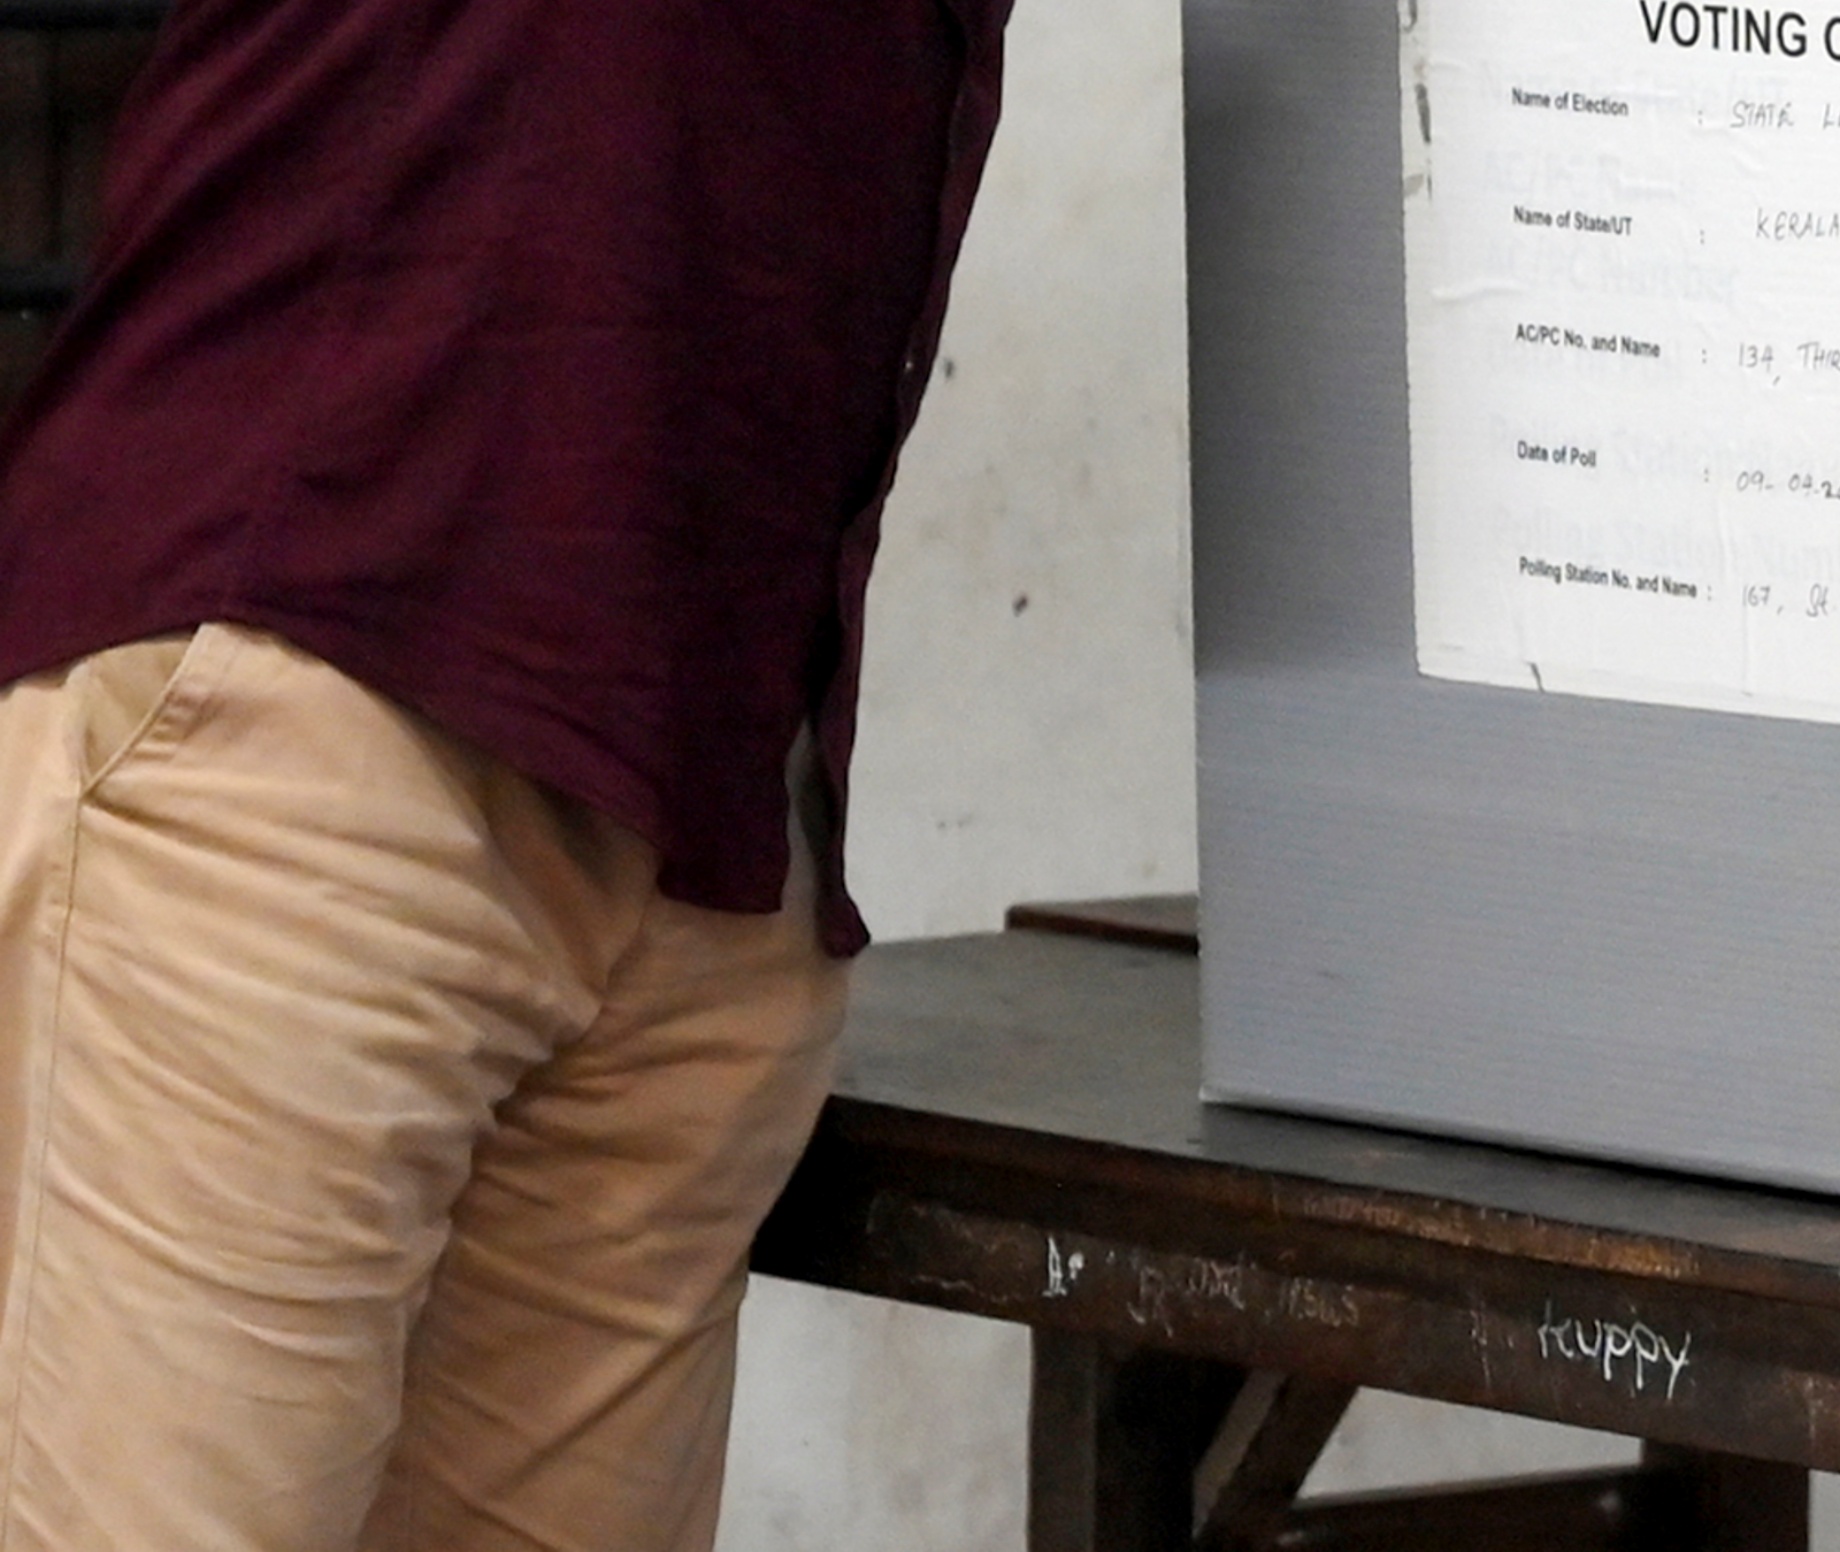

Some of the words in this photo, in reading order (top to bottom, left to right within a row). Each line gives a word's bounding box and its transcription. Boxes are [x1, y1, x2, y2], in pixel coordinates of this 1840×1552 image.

[1511, 86, 1552, 110] Name
[1553, 90, 1570, 111] of
[1571, 92, 1630, 117] Election
[1729, 98, 1796, 130] STATE
[1512, 204, 1554, 228] Name
[1555, 209, 1572, 229] of
[1573, 210, 1633, 237] State/UT
[1755, 206, 1840, 243] KERALA
[1514, 322, 1561, 347] AC/PC
[1563, 328, 1588, 351] No.
[1590, 334, 1618, 354] and
[1620, 335, 1662, 359] Name
[1737, 341, 1782, 387] 134,
[1516, 439, 1550, 463] Date
[1551, 444, 1568, 465] of
[1569, 445, 1598, 469] Poll
[1518, 555, 1563, 586] Polling
[1564, 561, 1610, 586] Station
[1610, 568, 1633, 590] No.
[1635, 574, 1660, 594] and
[1661, 575, 1699, 600] Name
